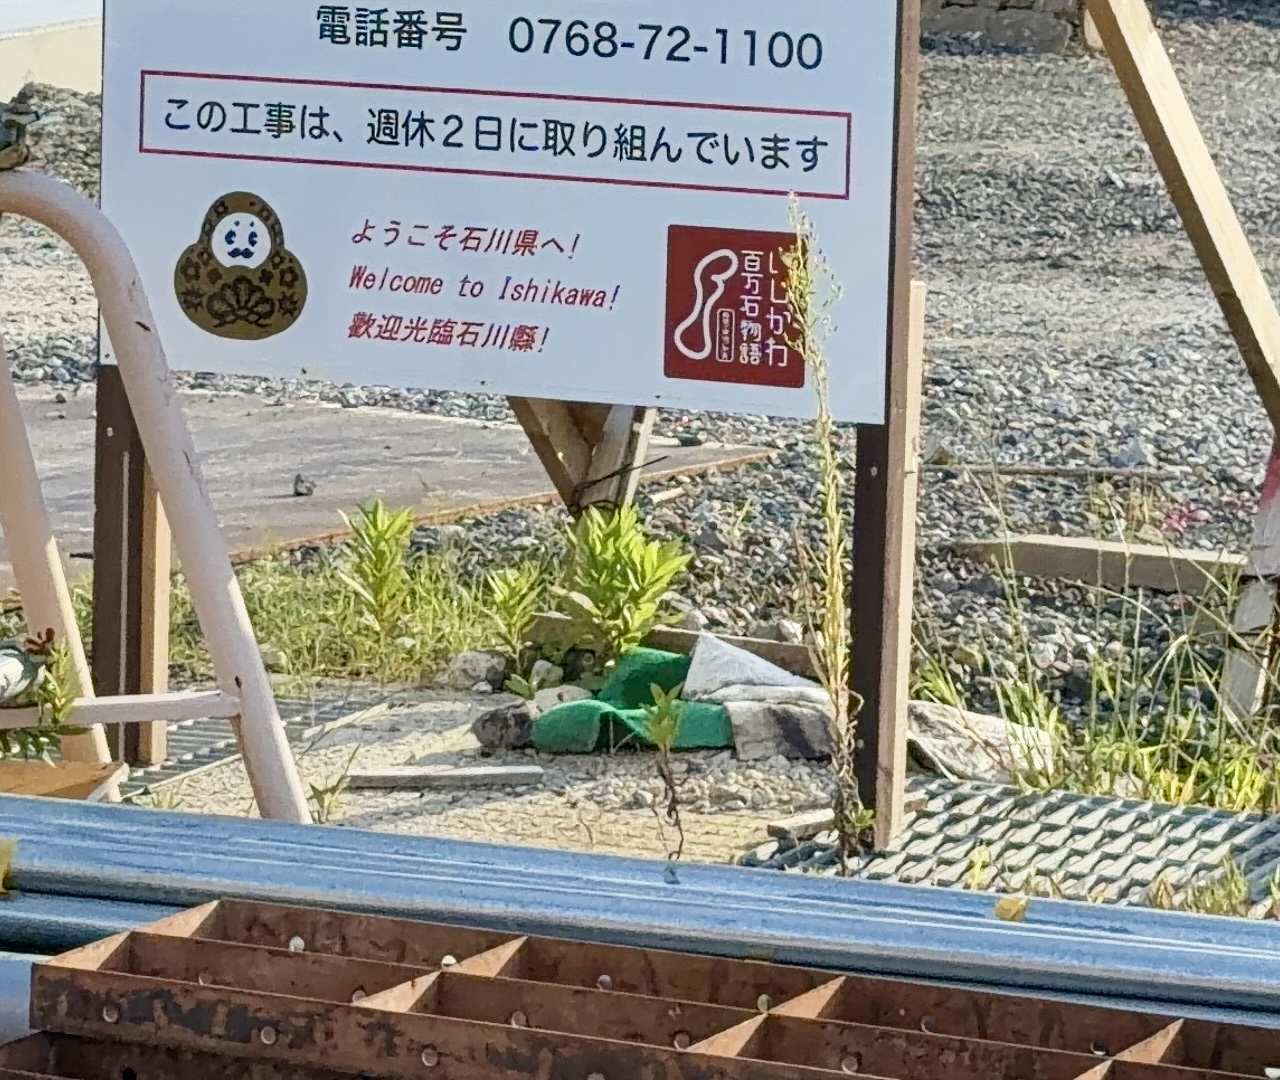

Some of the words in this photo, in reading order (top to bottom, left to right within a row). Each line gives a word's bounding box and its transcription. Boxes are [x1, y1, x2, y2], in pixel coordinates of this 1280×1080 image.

[316, 5, 468, 52] 電話番号
[508, 16, 823, 70] 0768-72-1100
[348, 264, 444, 296] Welcome
[458, 274, 484, 298] to
[498, 275, 621, 311] Ishikawa!
